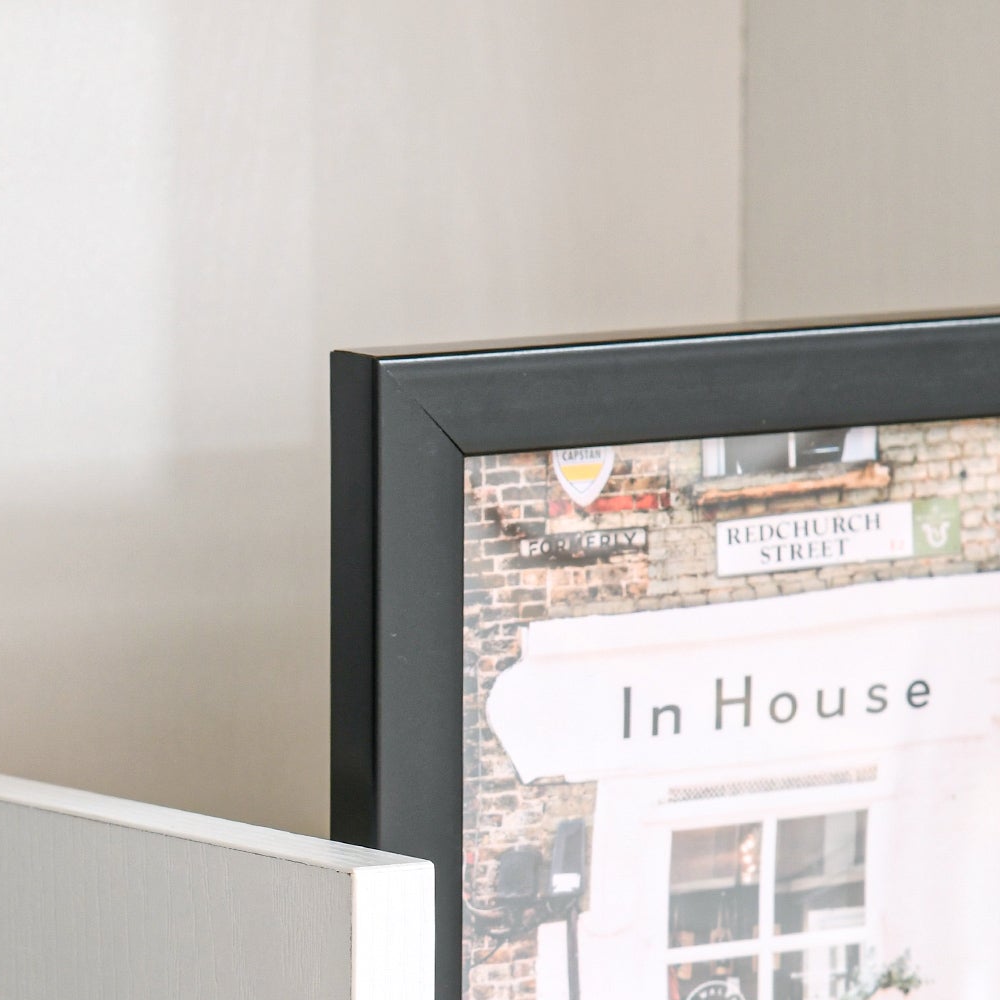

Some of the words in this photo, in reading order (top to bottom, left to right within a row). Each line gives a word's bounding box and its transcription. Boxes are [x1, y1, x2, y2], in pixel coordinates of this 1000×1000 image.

[561, 449, 601, 461] CAPSTAN
[727, 512, 881, 545] REDCHURCH
[760, 538, 848, 566] STREET
[622, 686, 682, 740] In
[714, 674, 931, 731] House
